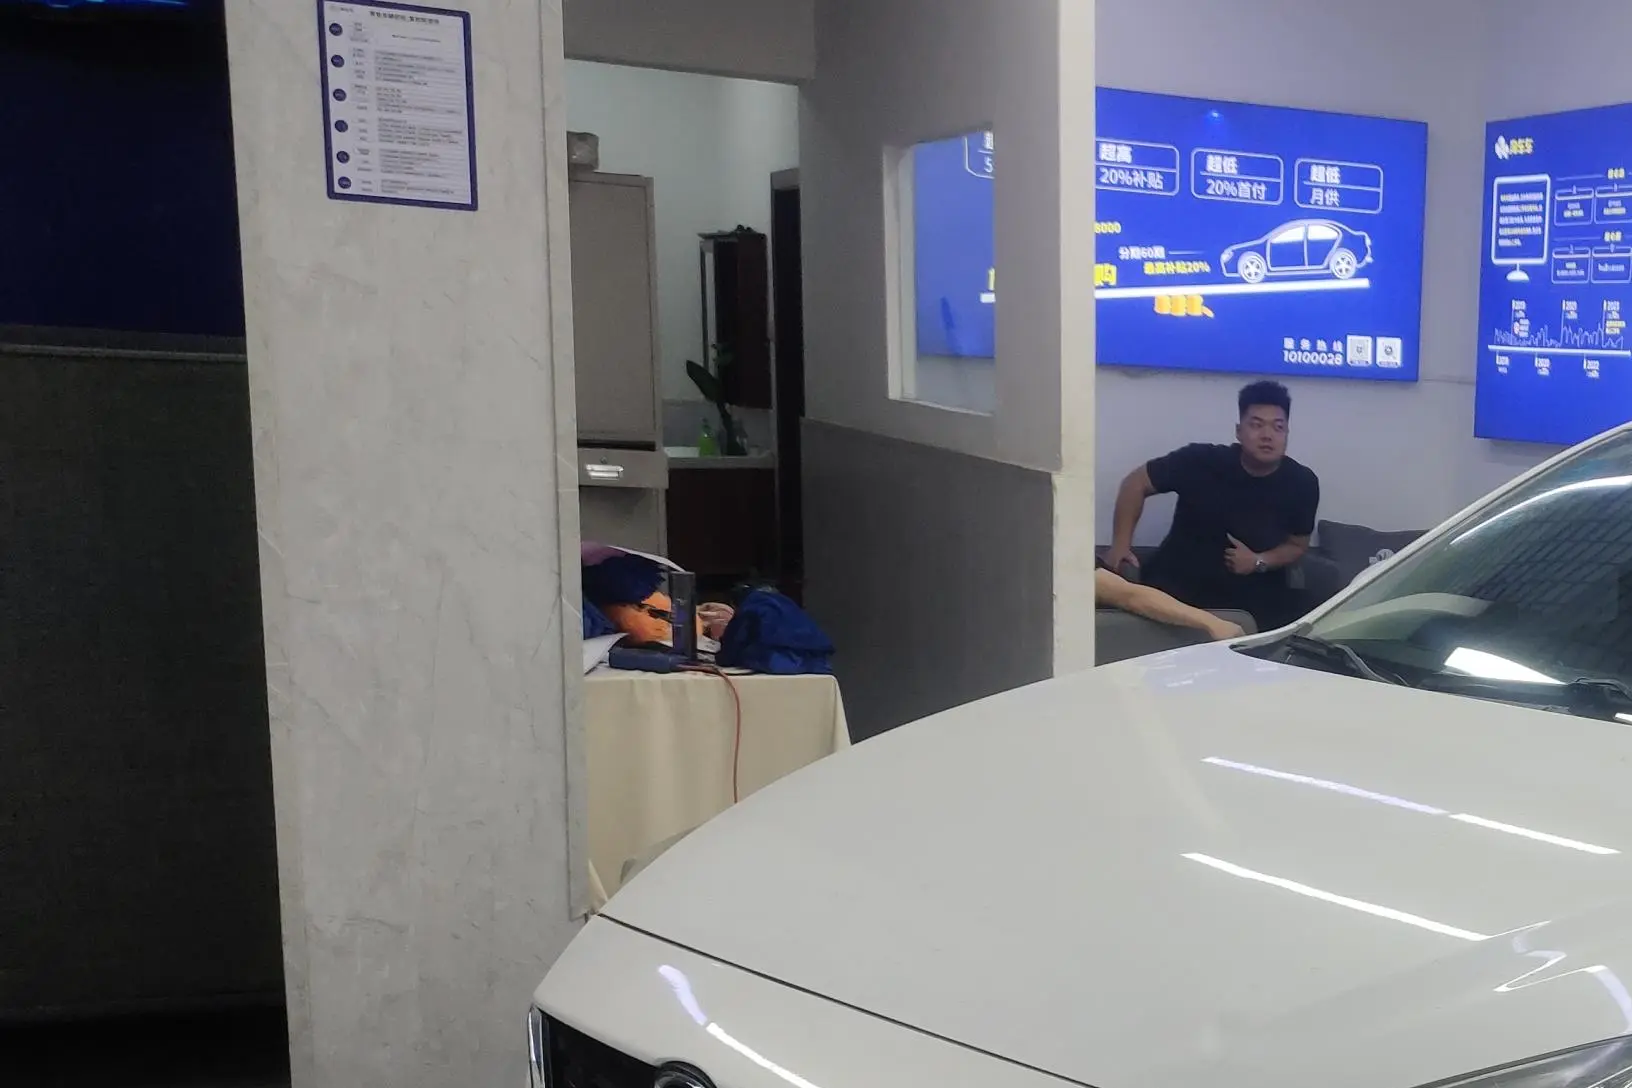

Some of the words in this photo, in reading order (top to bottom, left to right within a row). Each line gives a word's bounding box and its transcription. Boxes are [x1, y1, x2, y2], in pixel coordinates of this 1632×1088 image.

[1100, 143, 1133, 164] 超高
[1206, 154, 1239, 175] 超低
[1310, 164, 1342, 185] 超低
[1099, 167, 1165, 191] 20%补贴
[1206, 178, 1268, 201] 20%首付
[1310, 186, 1342, 207] 月供
[1283, 350, 1344, 366] 10100028
